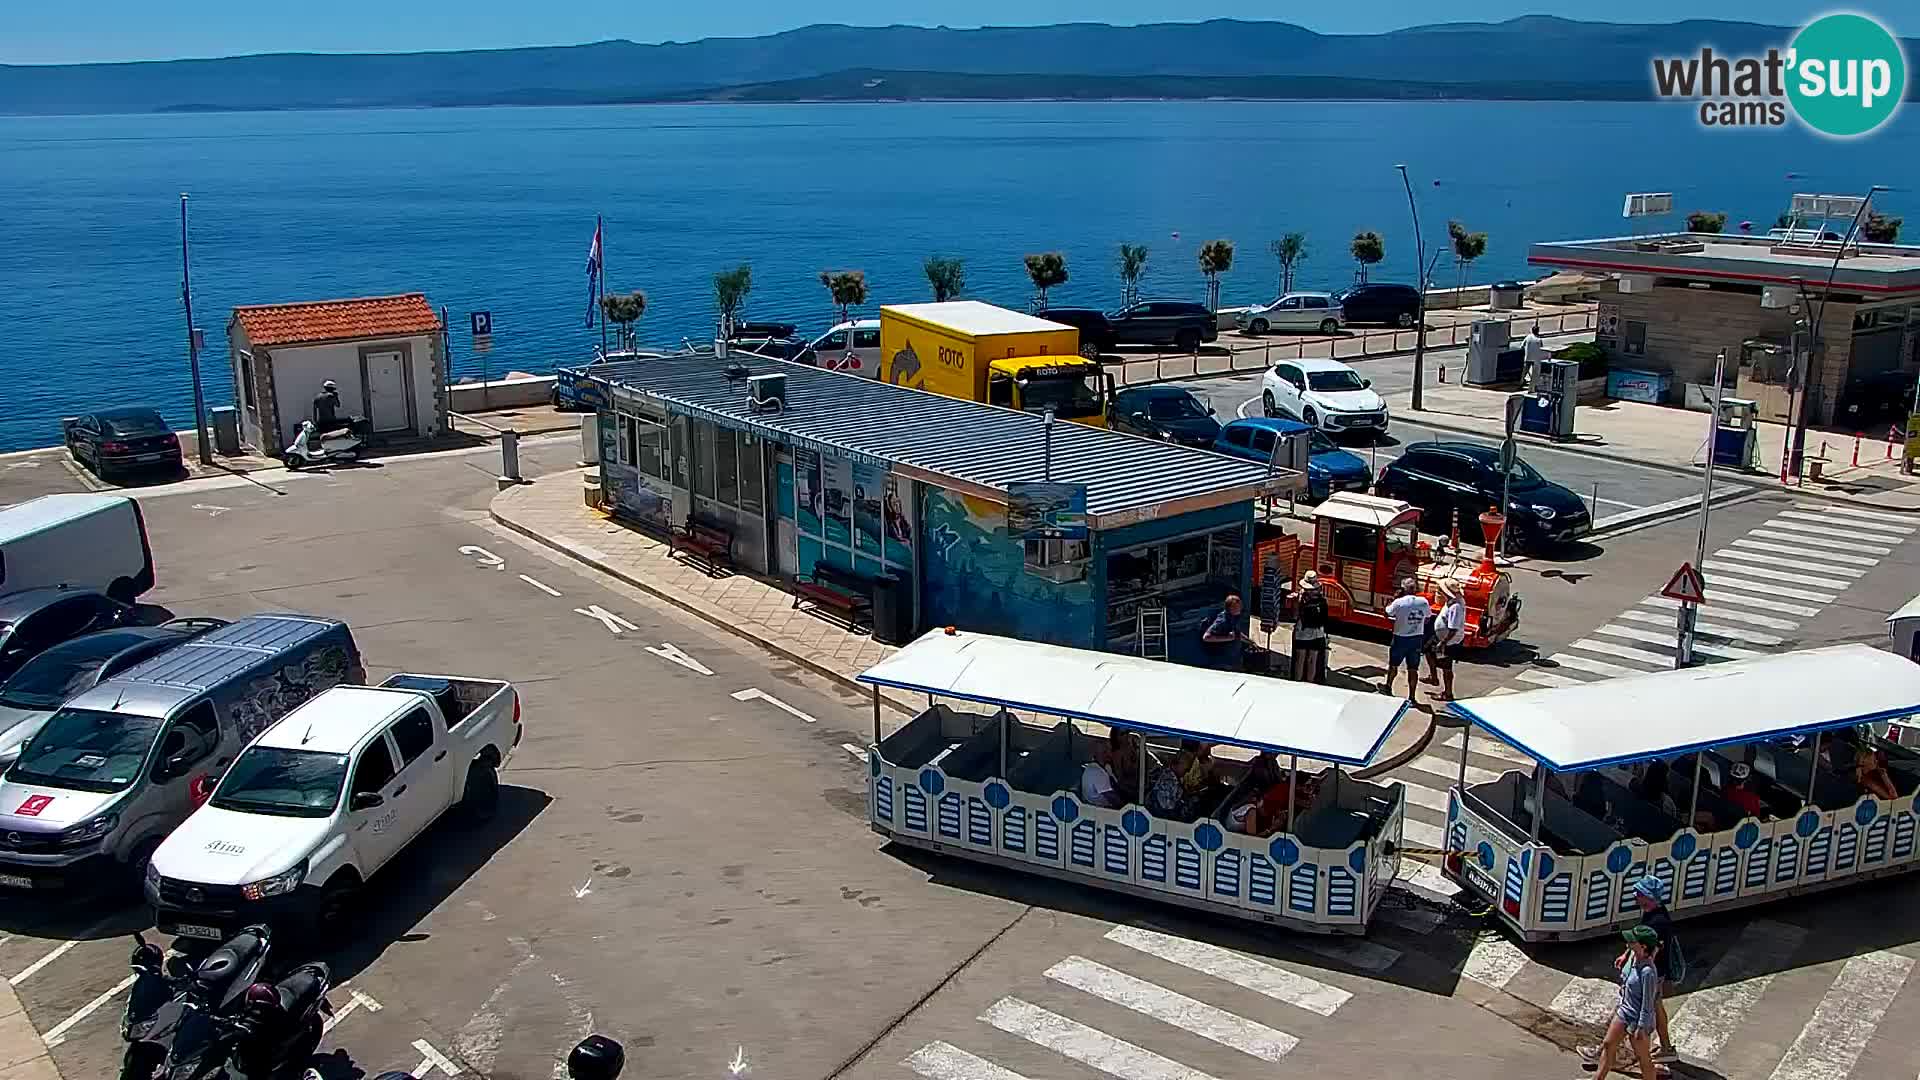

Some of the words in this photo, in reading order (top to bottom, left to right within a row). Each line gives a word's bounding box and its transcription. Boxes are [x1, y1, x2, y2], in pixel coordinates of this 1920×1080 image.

[475, 314, 487, 331] P
[938, 345, 965, 369] ROTO
[1036, 367, 1058, 376] ROTO
[789, 436, 803, 448] BUS
[805, 441, 834, 456] STATION
[838, 448, 861, 463] TICKET
[862, 456, 889, 469] OFFICE
